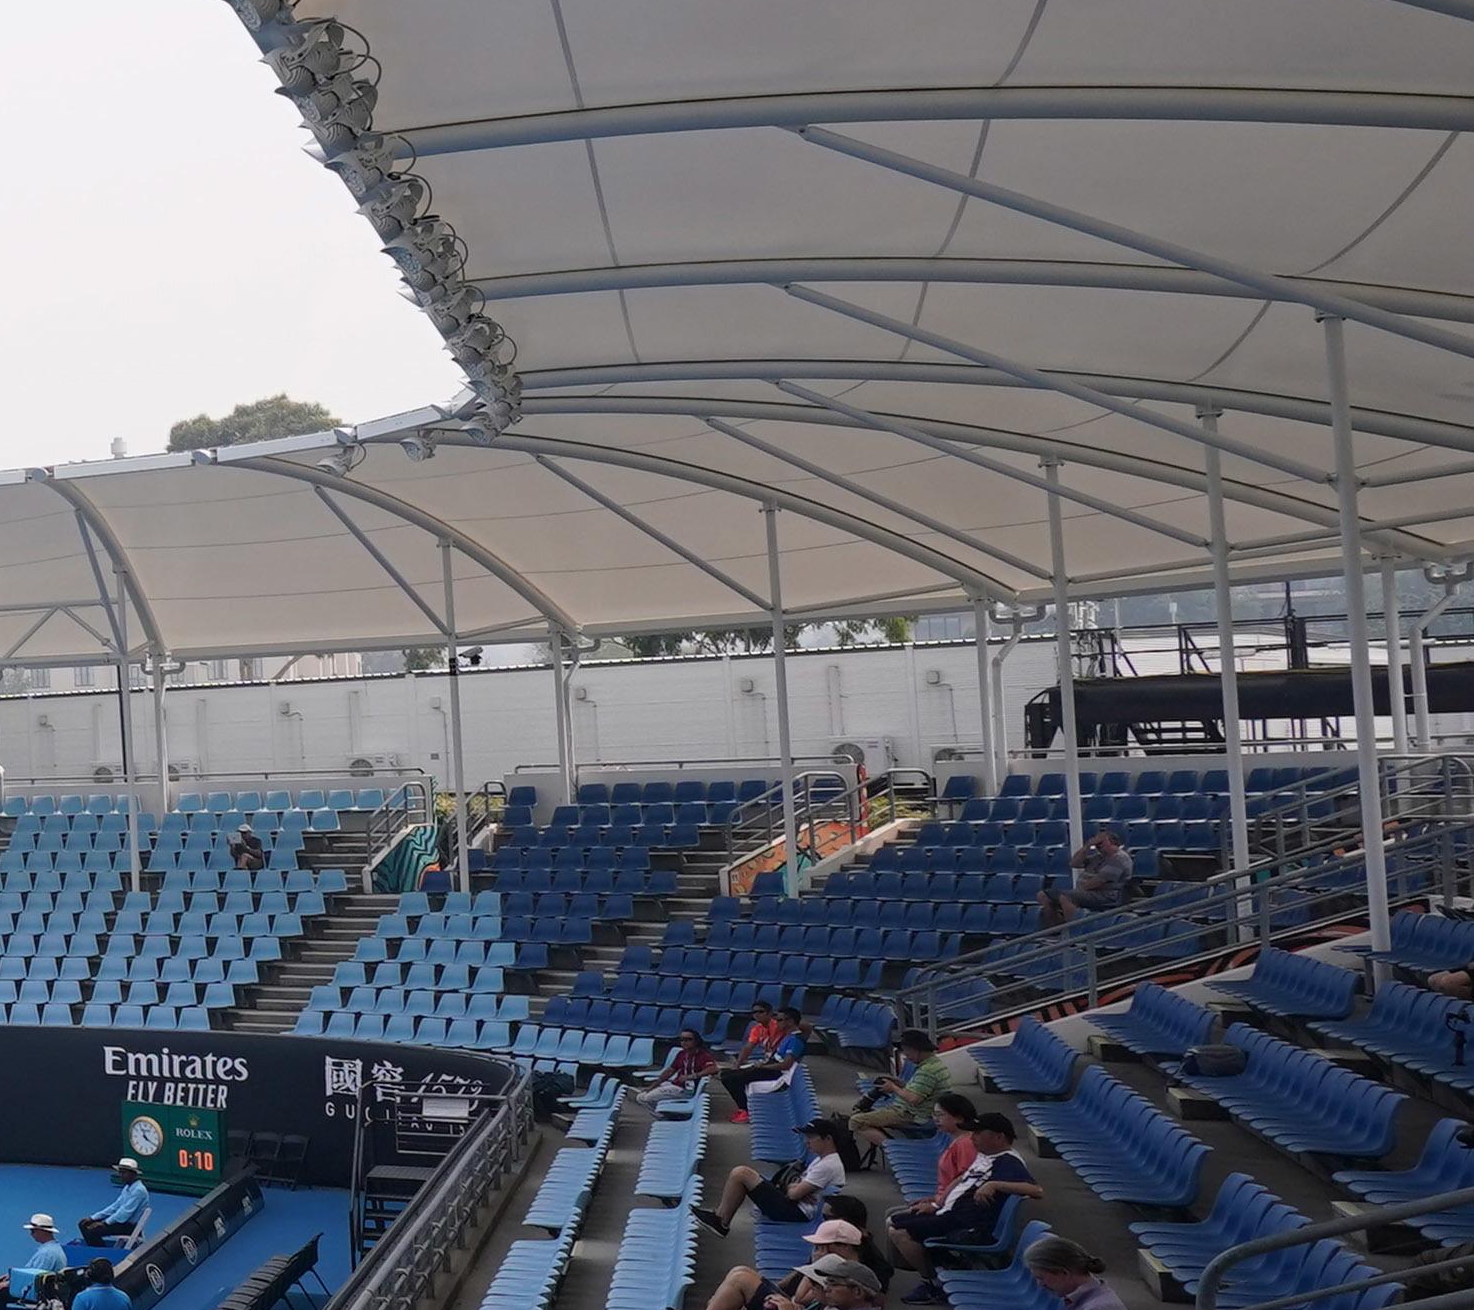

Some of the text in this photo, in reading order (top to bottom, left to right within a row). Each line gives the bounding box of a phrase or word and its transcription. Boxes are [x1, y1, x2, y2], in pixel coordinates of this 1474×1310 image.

[103, 1045, 249, 1081] Emirates
[127, 1080, 228, 1108] FLY BETTER
[175, 1127, 213, 1140] ROLEX
[179, 1149, 214, 1171] 0:10
